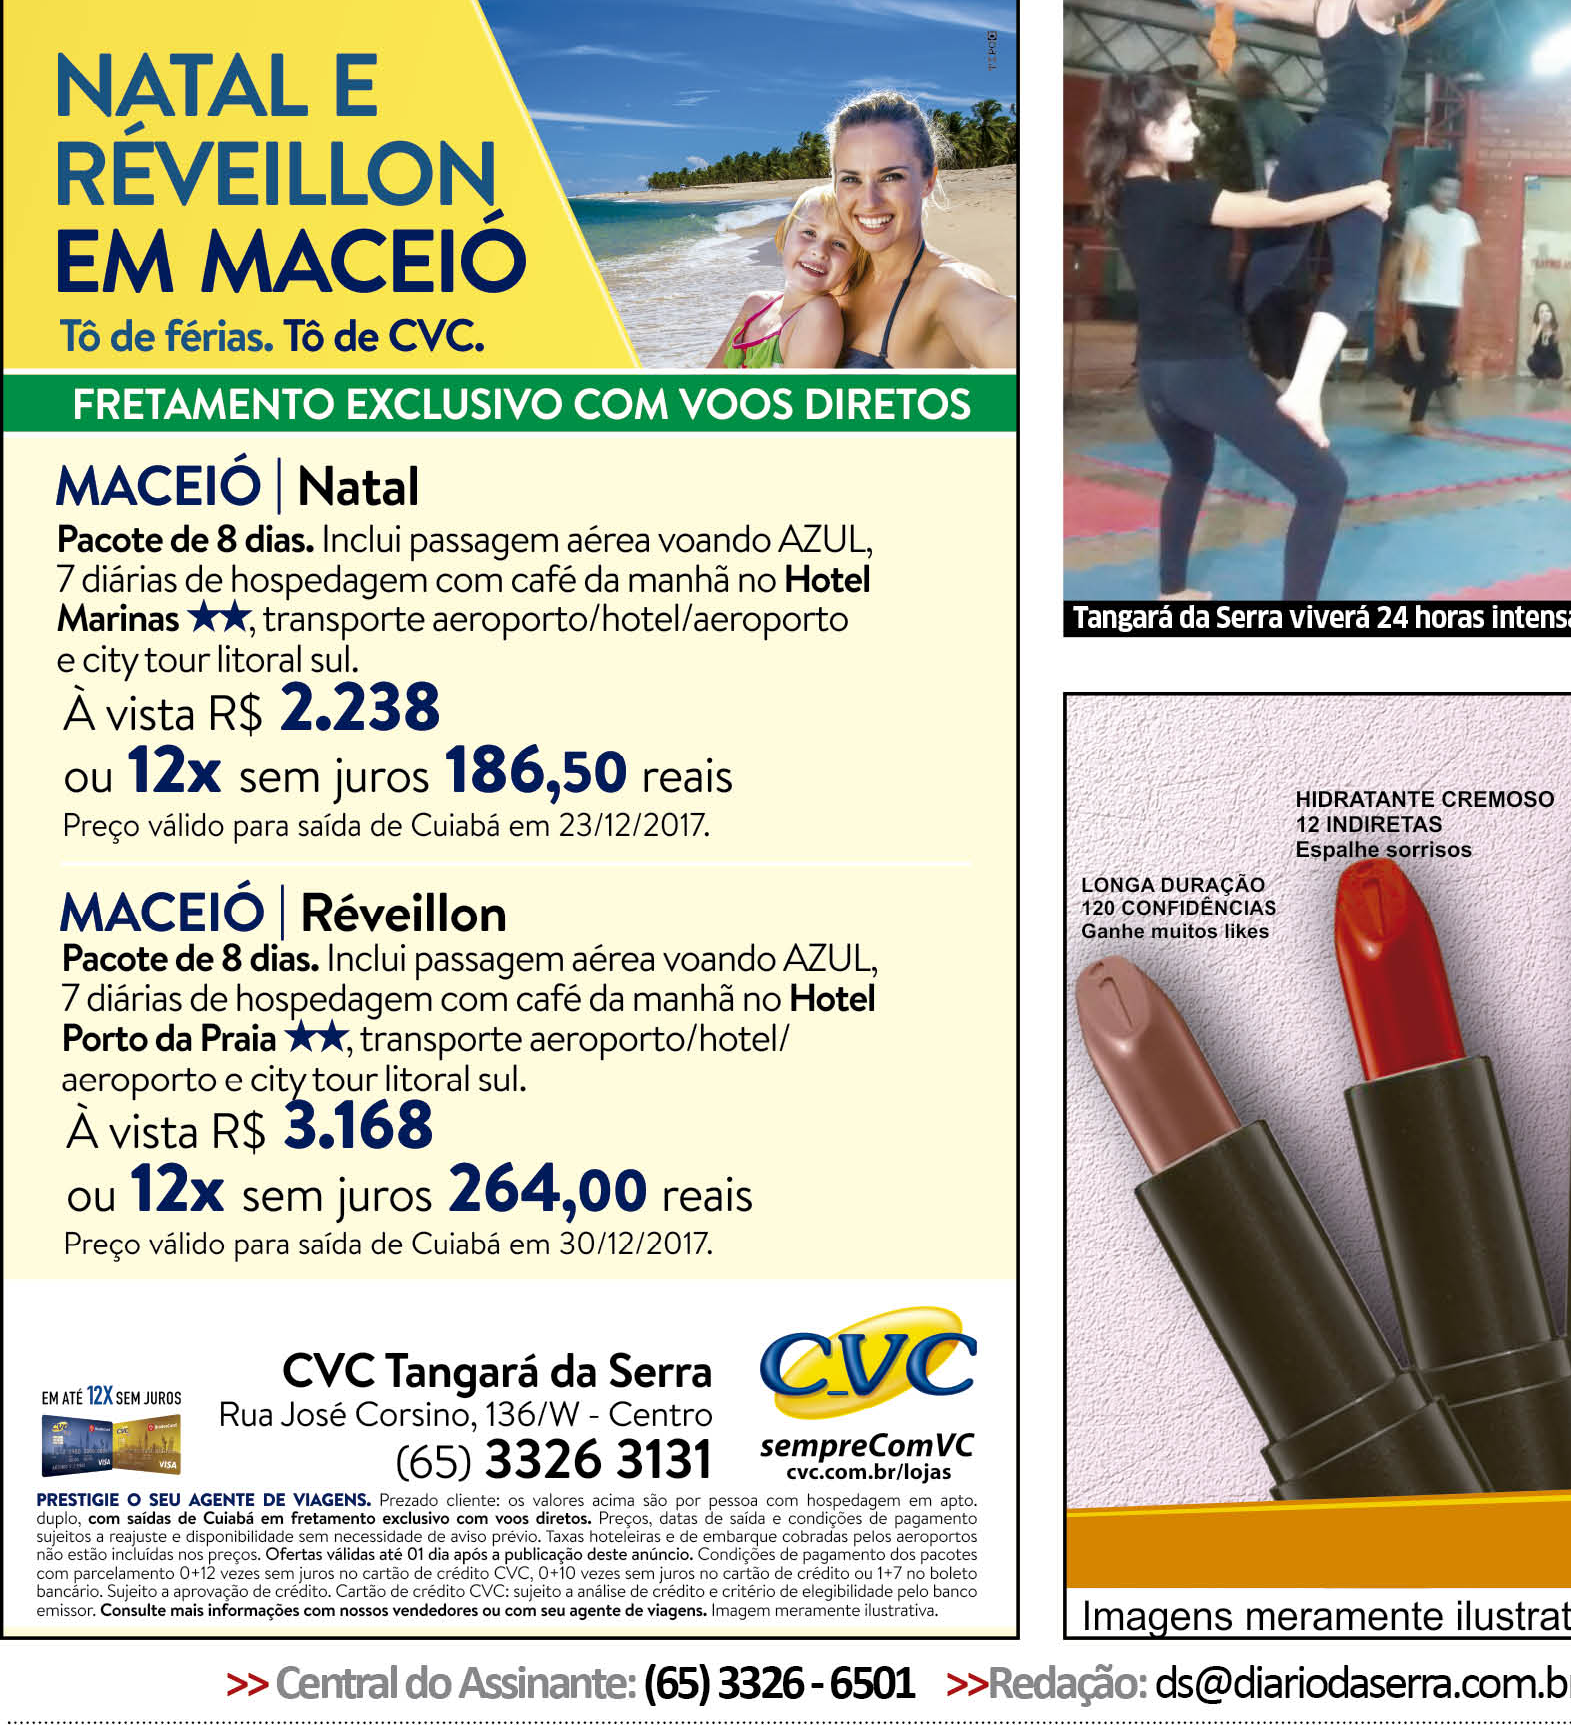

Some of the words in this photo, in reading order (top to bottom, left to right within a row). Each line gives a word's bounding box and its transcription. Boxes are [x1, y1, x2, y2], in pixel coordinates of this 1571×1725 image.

[57, 51, 309, 118] NATAL
[335, 52, 378, 117] E
[57, 120, 495, 207] RÉVEILLON
[57, 227, 174, 294] EM
[200, 207, 527, 294] MACEIÓ
[74, 387, 335, 421] FRETAMENTO
[347, 387, 563, 421] EXCLUSIVO
[573, 387, 669, 421] COM
[678, 387, 794, 421] VOOS
[805, 387, 971, 421] DIRETOS
[62, 683, 96, 731] À
[105, 694, 194, 732] vista
[210, 691, 263, 738] R$
[280, 680, 440, 732] 2.238
[759, 1331, 978, 1397] CVC
[41, 1390, 59, 1406] EM
[61, 1387, 84, 1406] ATÉ
[86, 1384, 114, 1406] 12X
[115, 1390, 141, 1406] SEM
[143, 1390, 182, 1406] JUROS
[158, 1459, 178, 1470] VISA
[396, 1443, 471, 1483] (65)
[485, 1437, 602, 1480] 3326
[616, 1437, 710, 1480] 3131
[759, 1432, 976, 1464] sempreComVC
[786, 1462, 952, 1485] cvc.com.br/lojas
